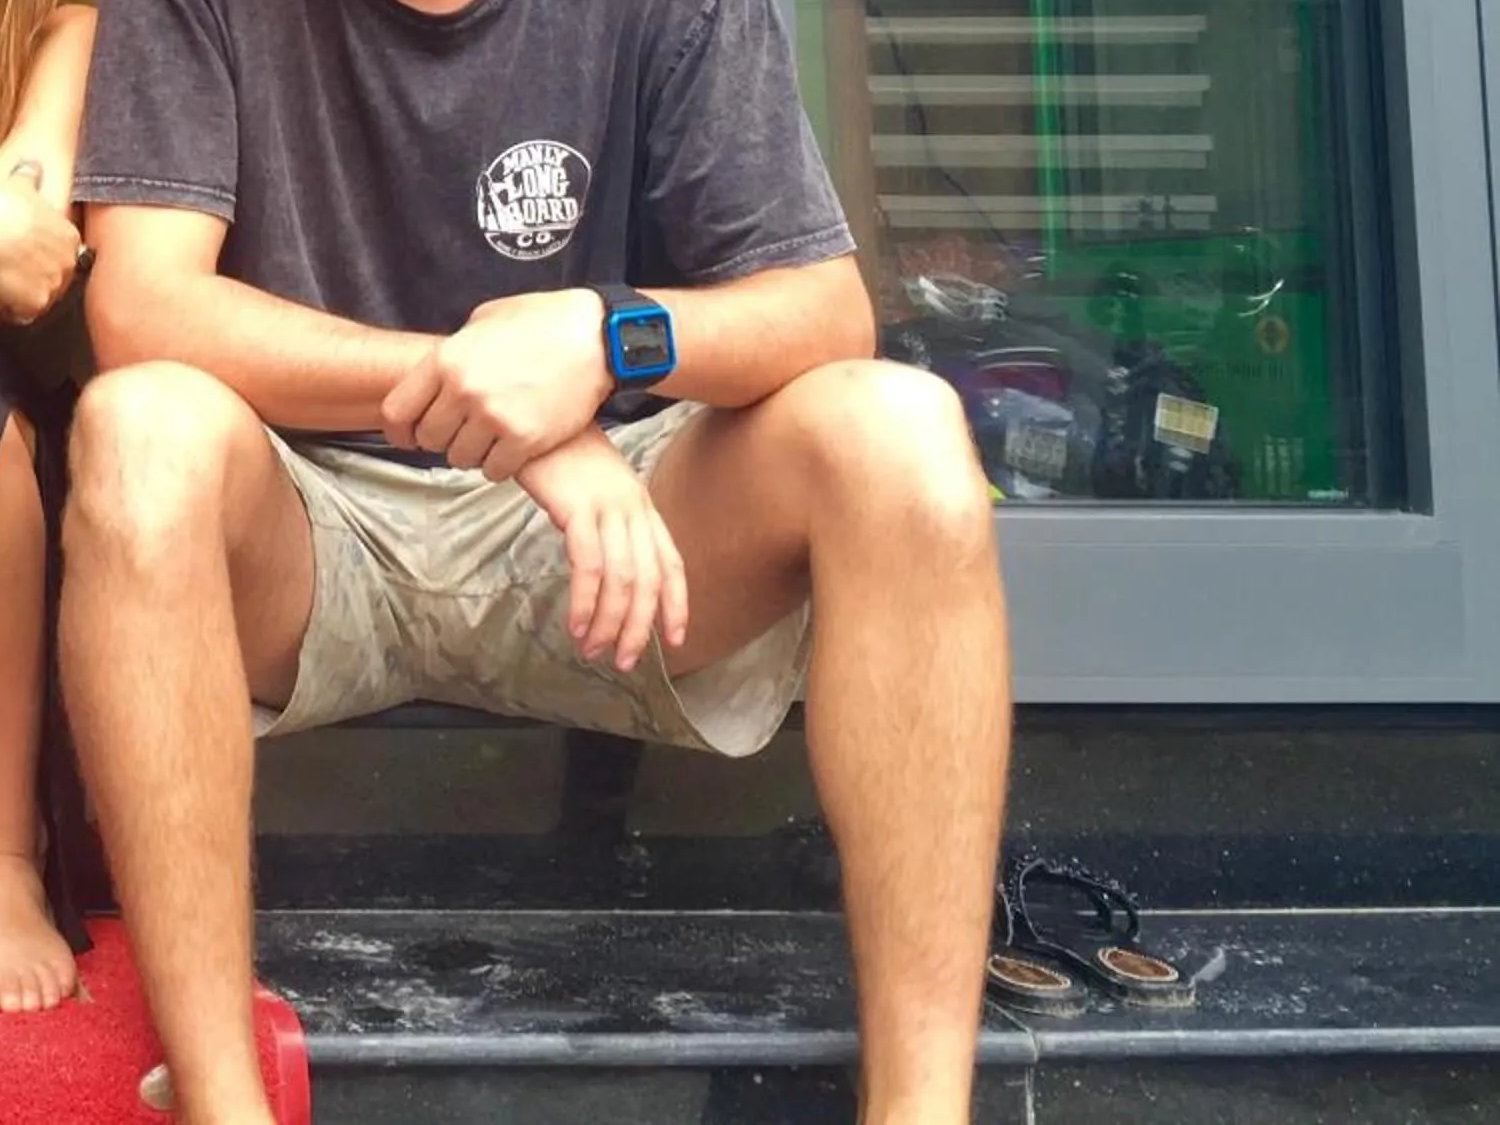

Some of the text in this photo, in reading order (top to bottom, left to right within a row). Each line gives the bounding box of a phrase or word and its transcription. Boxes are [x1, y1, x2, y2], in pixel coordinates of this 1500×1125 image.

[503, 145, 570, 175] MANLY
[503, 164, 571, 203] LONG
[505, 198, 578, 226] BOARD
